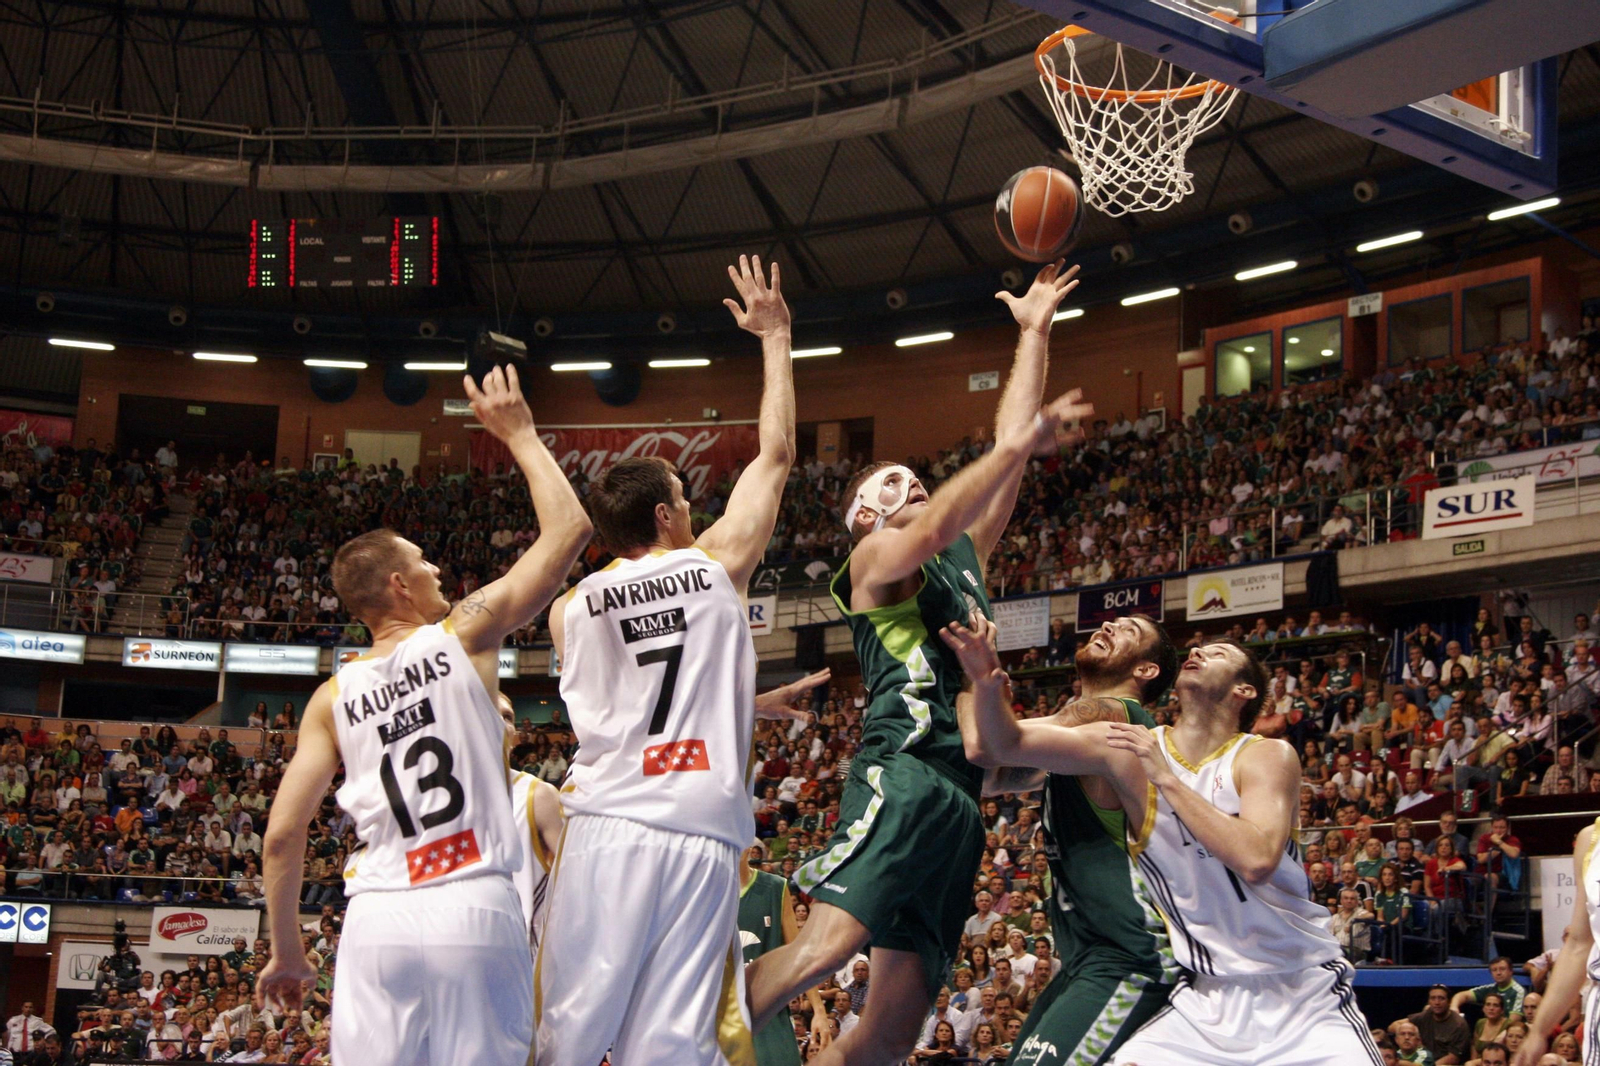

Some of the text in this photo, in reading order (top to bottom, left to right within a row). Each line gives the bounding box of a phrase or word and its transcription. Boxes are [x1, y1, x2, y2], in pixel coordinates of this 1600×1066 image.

[299, 237, 324, 245] LOCAL
[1437, 489, 1518, 518] SUR
[585, 568, 712, 618] LAVRINOVIC
[1104, 588, 1140, 610] BCM
[628, 611, 677, 634] MMT
[638, 628, 675, 638] SEGUROS
[153, 650, 215, 662] SURNEÓN
[635, 644, 684, 736] 7
[379, 736, 465, 839] 13
[160, 915, 206, 935] famadesa
